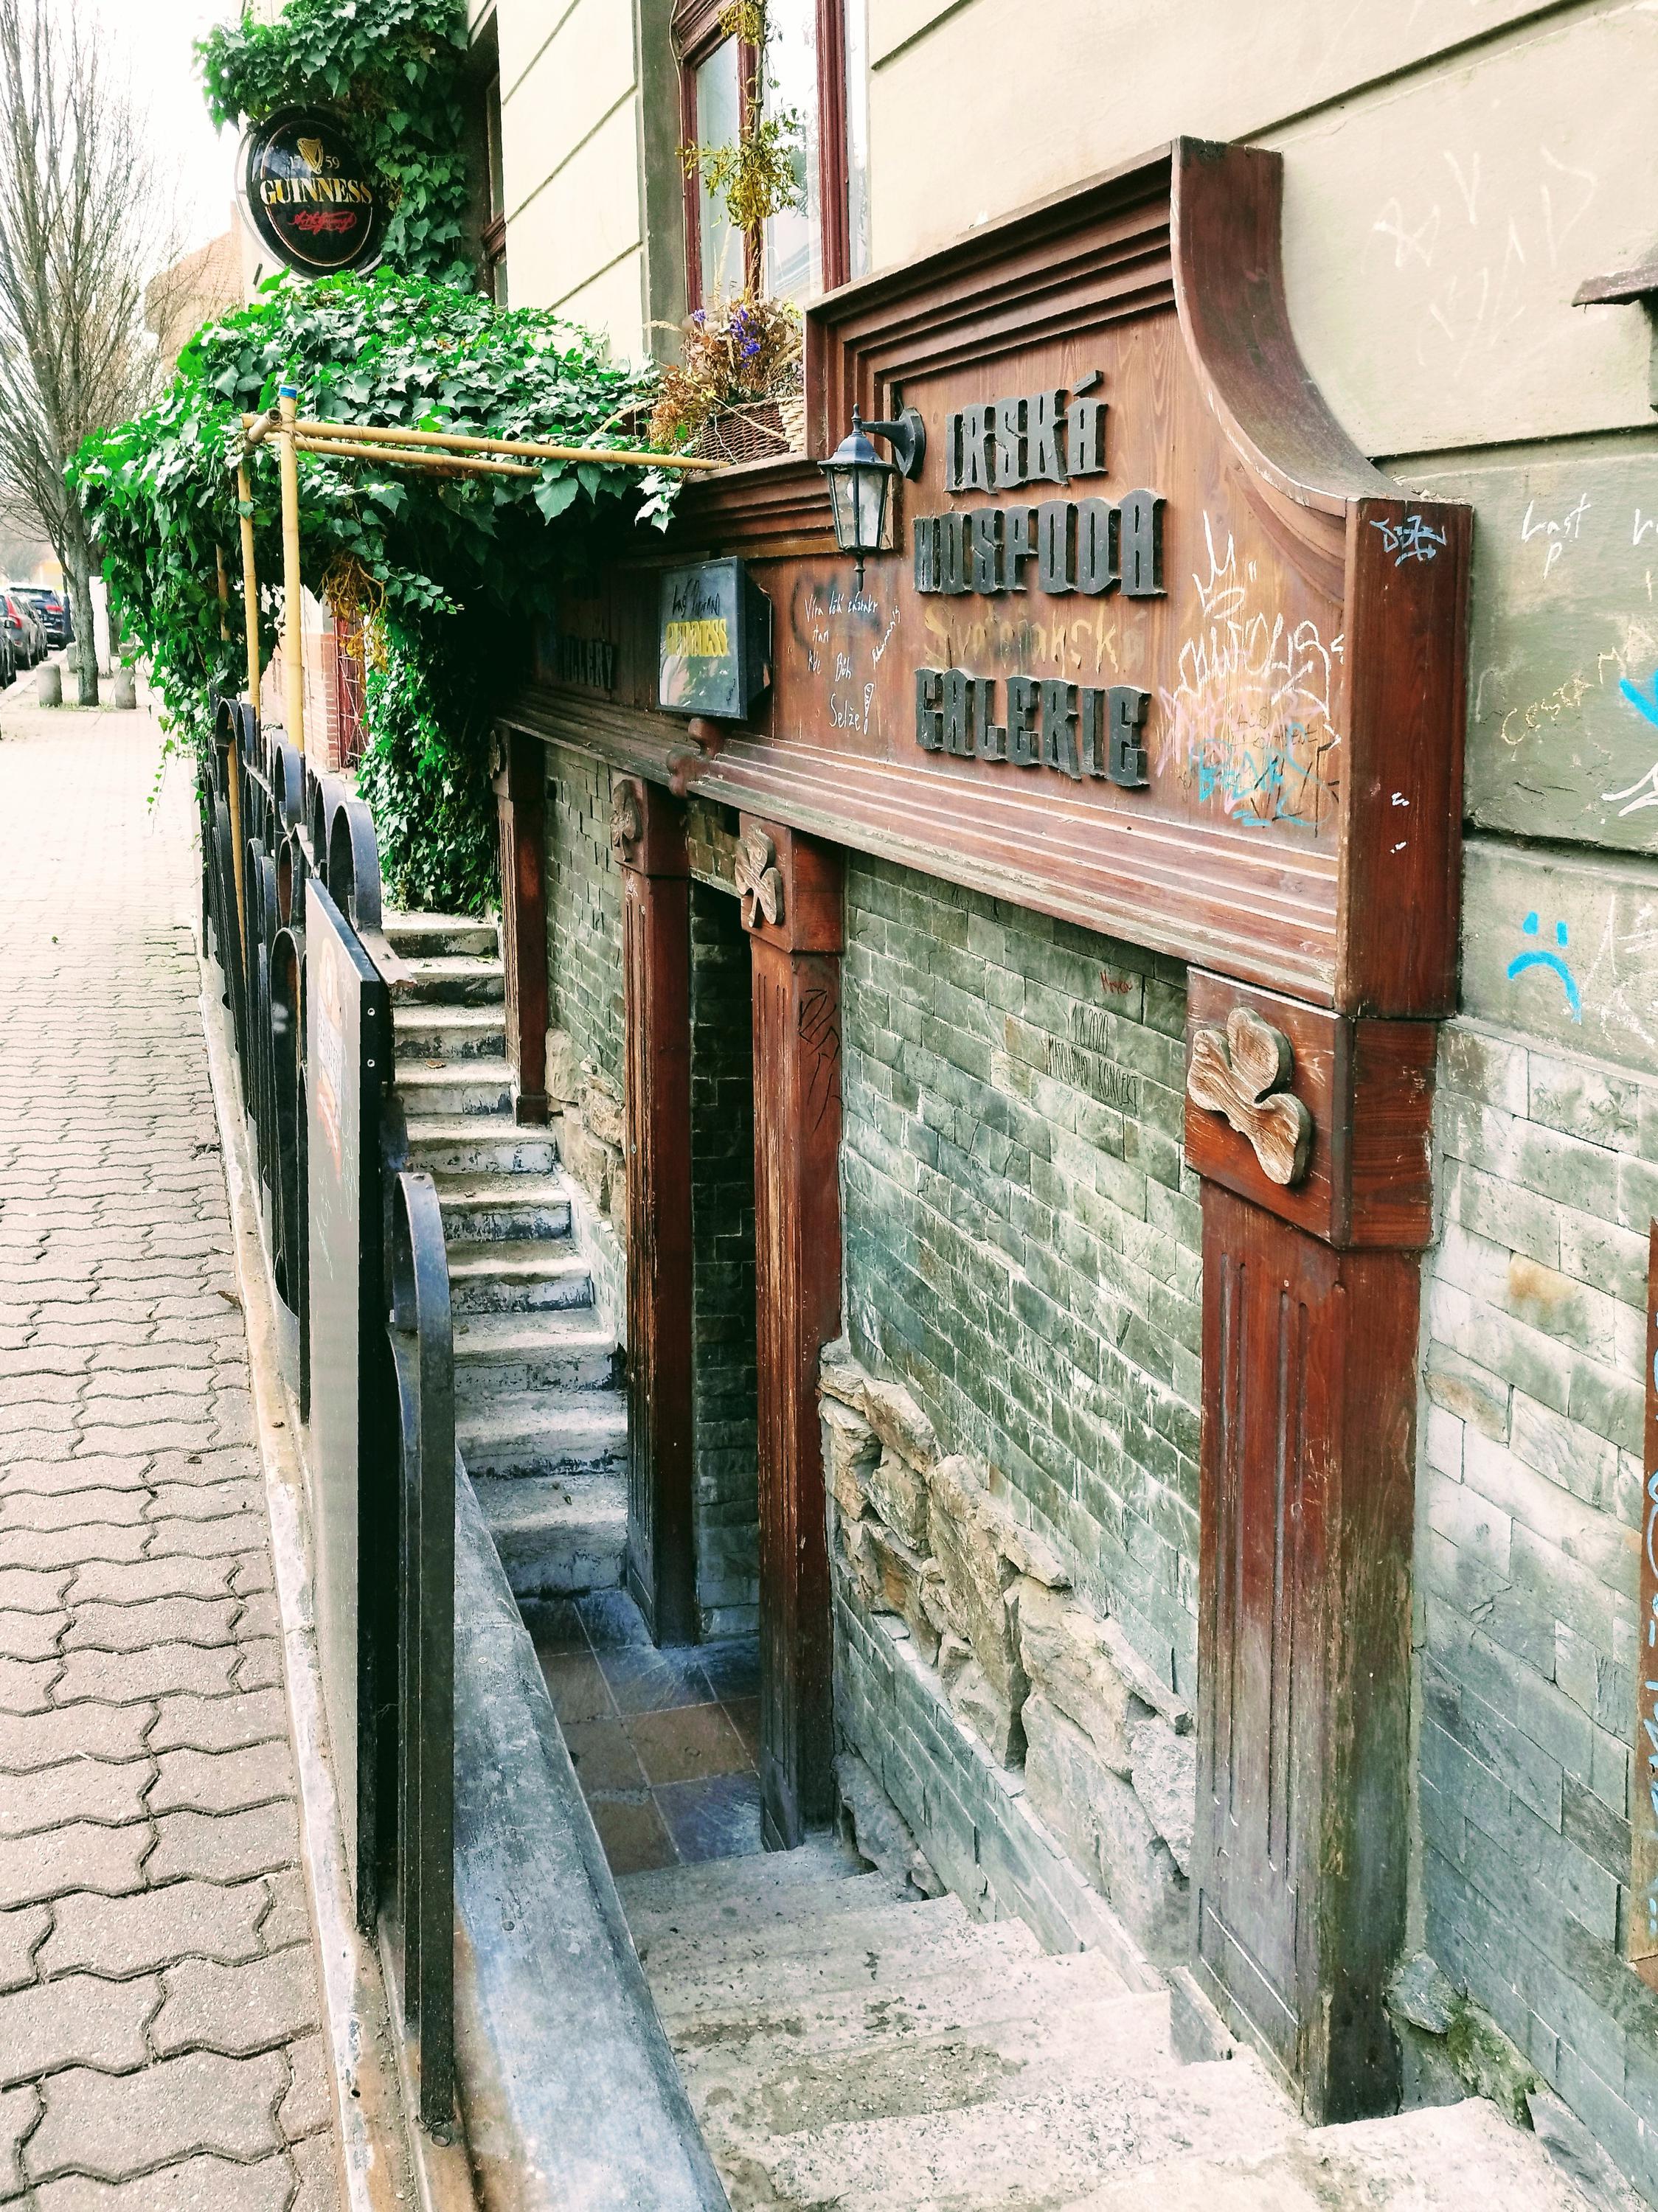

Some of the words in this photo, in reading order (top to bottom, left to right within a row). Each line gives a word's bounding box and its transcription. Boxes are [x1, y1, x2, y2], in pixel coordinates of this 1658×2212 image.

[260, 177, 372, 205] GUINNESS
[325, 156, 340, 169] 59
[945, 369, 1109, 495] IRSKÁ
[913, 488, 1168, 597] HOSPODA
[915, 667, 1152, 787] GALERIE
